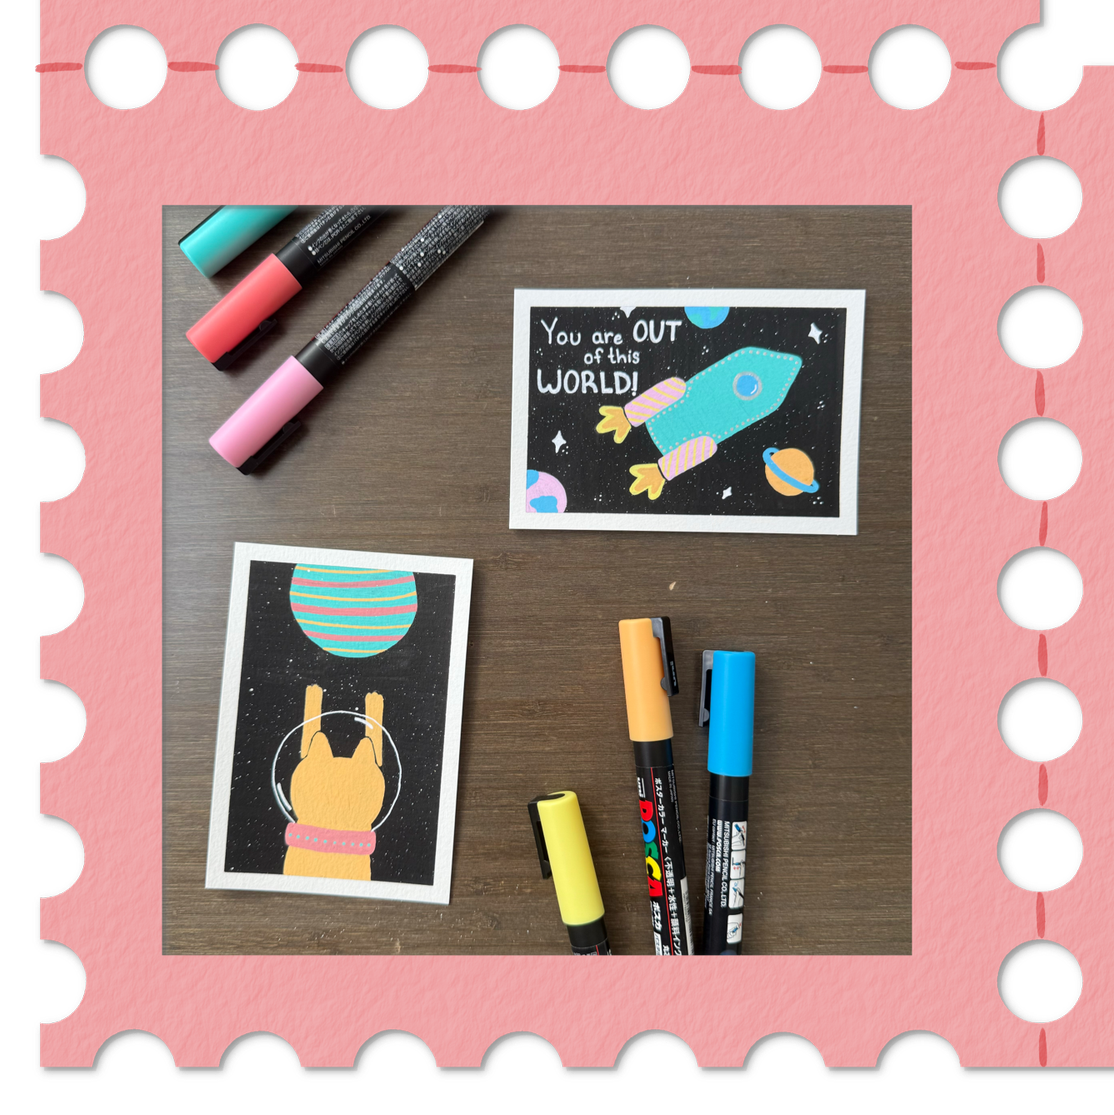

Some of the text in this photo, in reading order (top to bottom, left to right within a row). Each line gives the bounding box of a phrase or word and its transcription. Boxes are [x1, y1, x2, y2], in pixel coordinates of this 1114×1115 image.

[340, 229, 356, 245] PENCIL
[540, 317, 682, 346] You are OUT
[584, 347, 640, 365] of this
[536, 368, 639, 397] WORLD!
[639, 799, 663, 897] POSCA
[722, 820, 731, 858] MITSUBISHI
